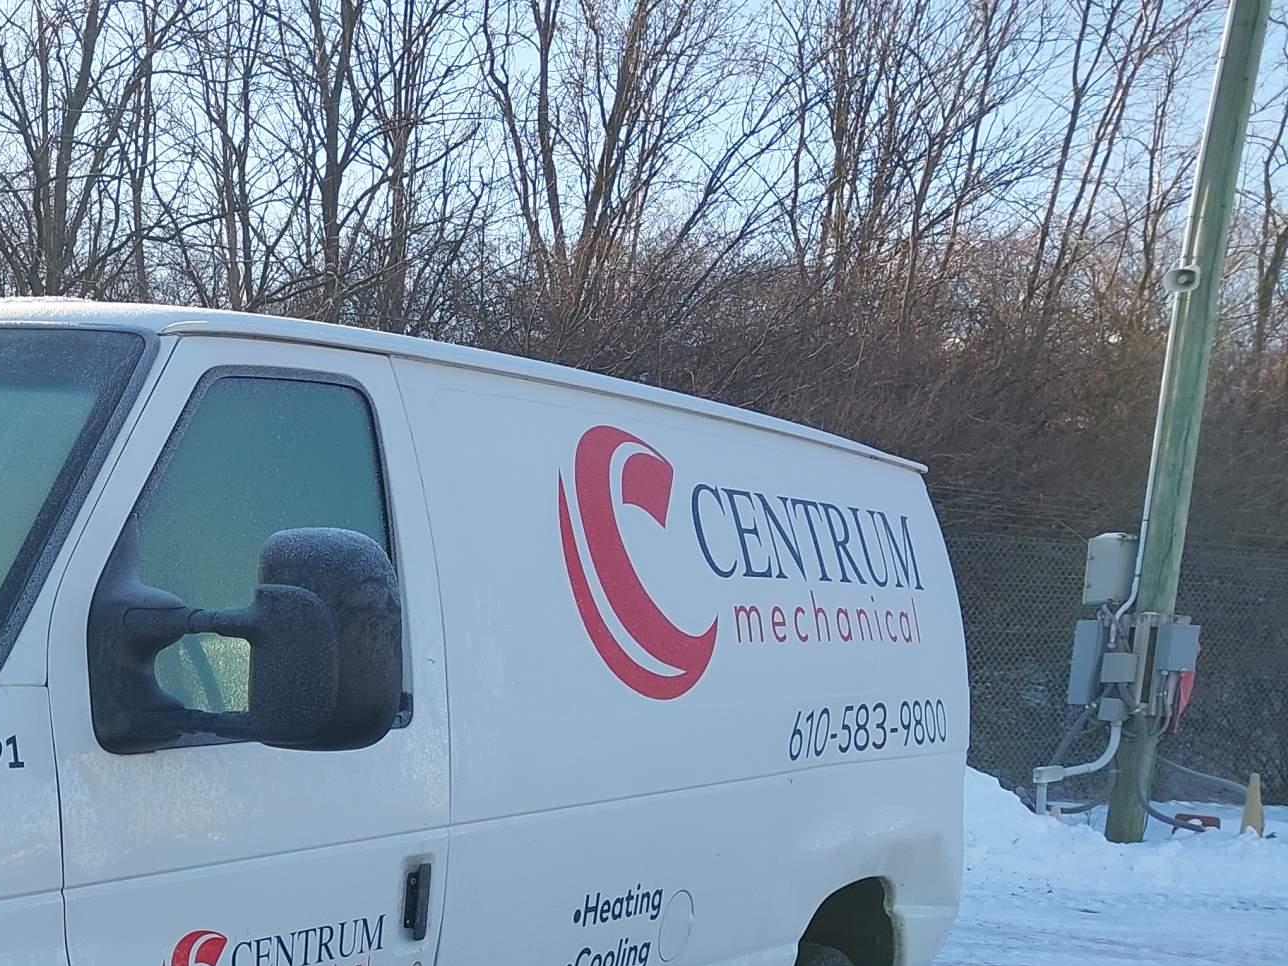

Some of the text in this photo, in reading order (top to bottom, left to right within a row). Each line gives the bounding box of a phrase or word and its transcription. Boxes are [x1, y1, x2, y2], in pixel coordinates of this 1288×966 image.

[691, 483, 925, 591] CENTRUM
[733, 590, 921, 644] mechanical
[788, 698, 947, 761] 610-583-9800
[581, 883, 663, 927] Heating
